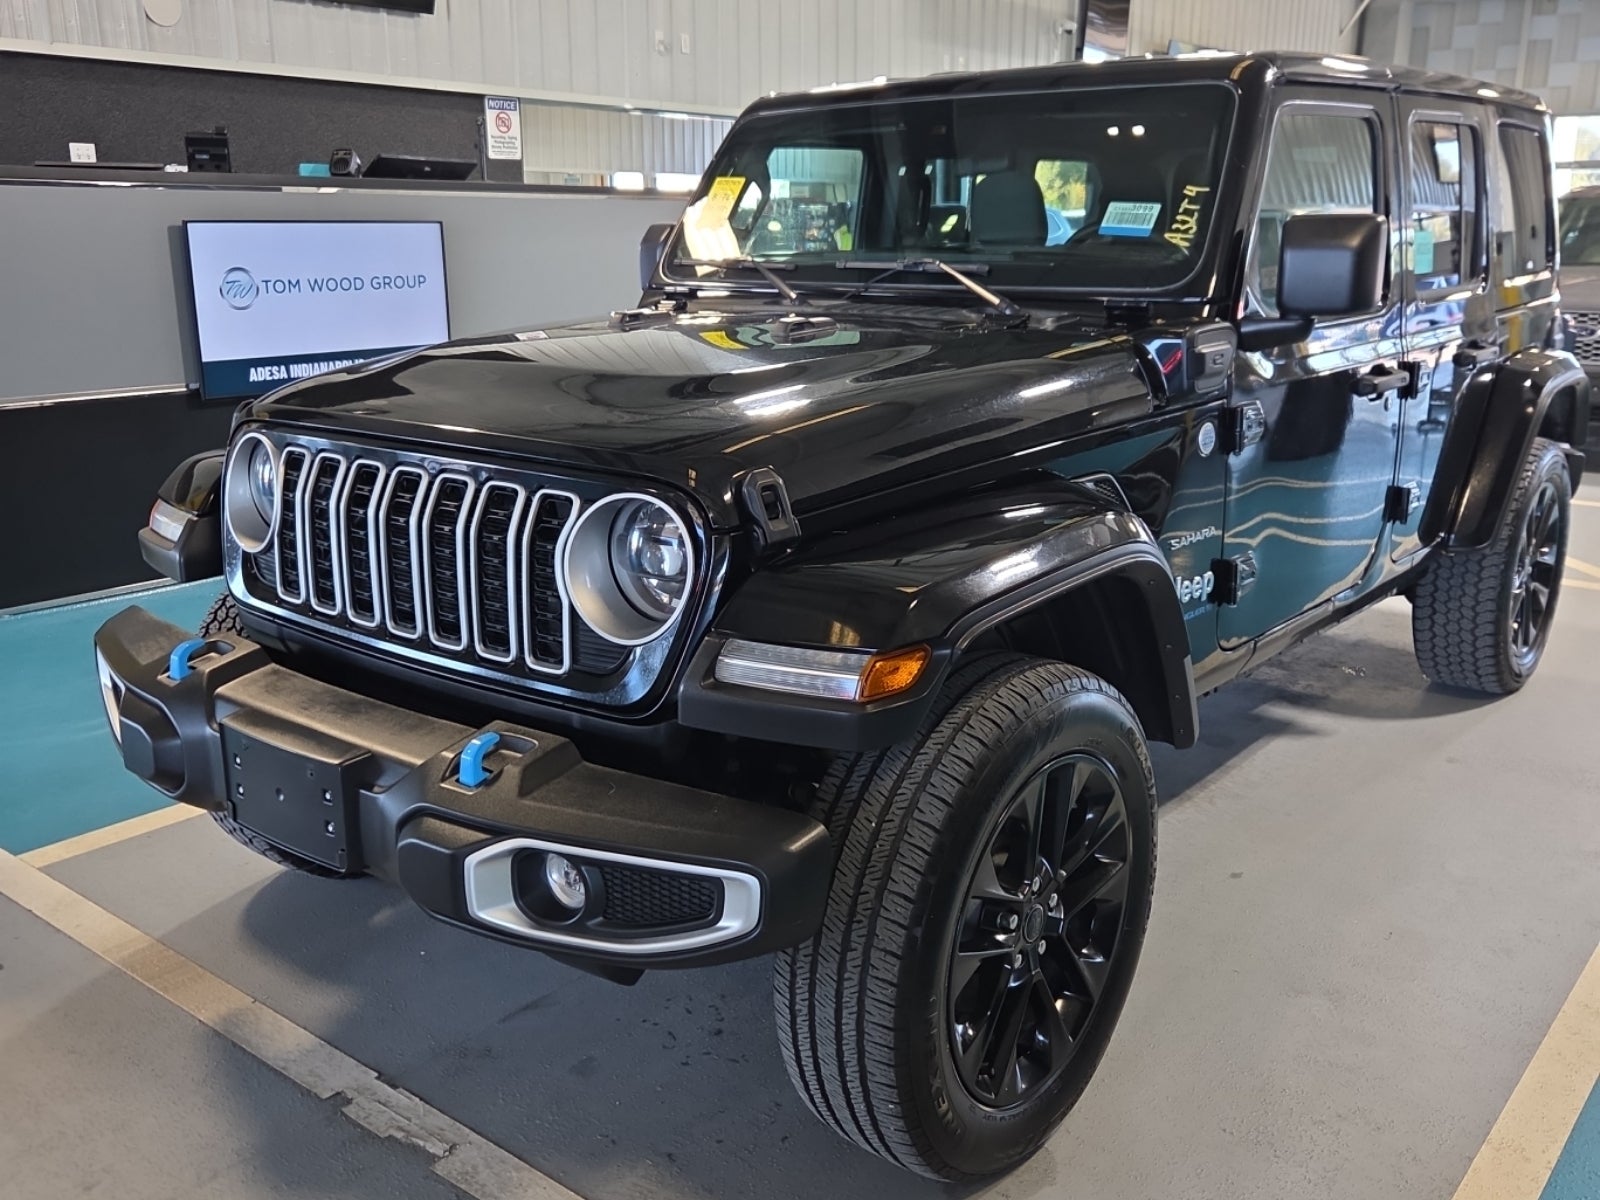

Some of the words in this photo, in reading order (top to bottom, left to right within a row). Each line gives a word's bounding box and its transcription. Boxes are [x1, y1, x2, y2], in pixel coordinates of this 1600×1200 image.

[488, 99, 516, 110] NOTICE
[261, 278, 301, 295] TOM
[307, 276, 365, 293] WOOD
[370, 274, 427, 291] GROUP
[249, 364, 288, 382] ADESA
[1168, 526, 1216, 551] SAHARA
